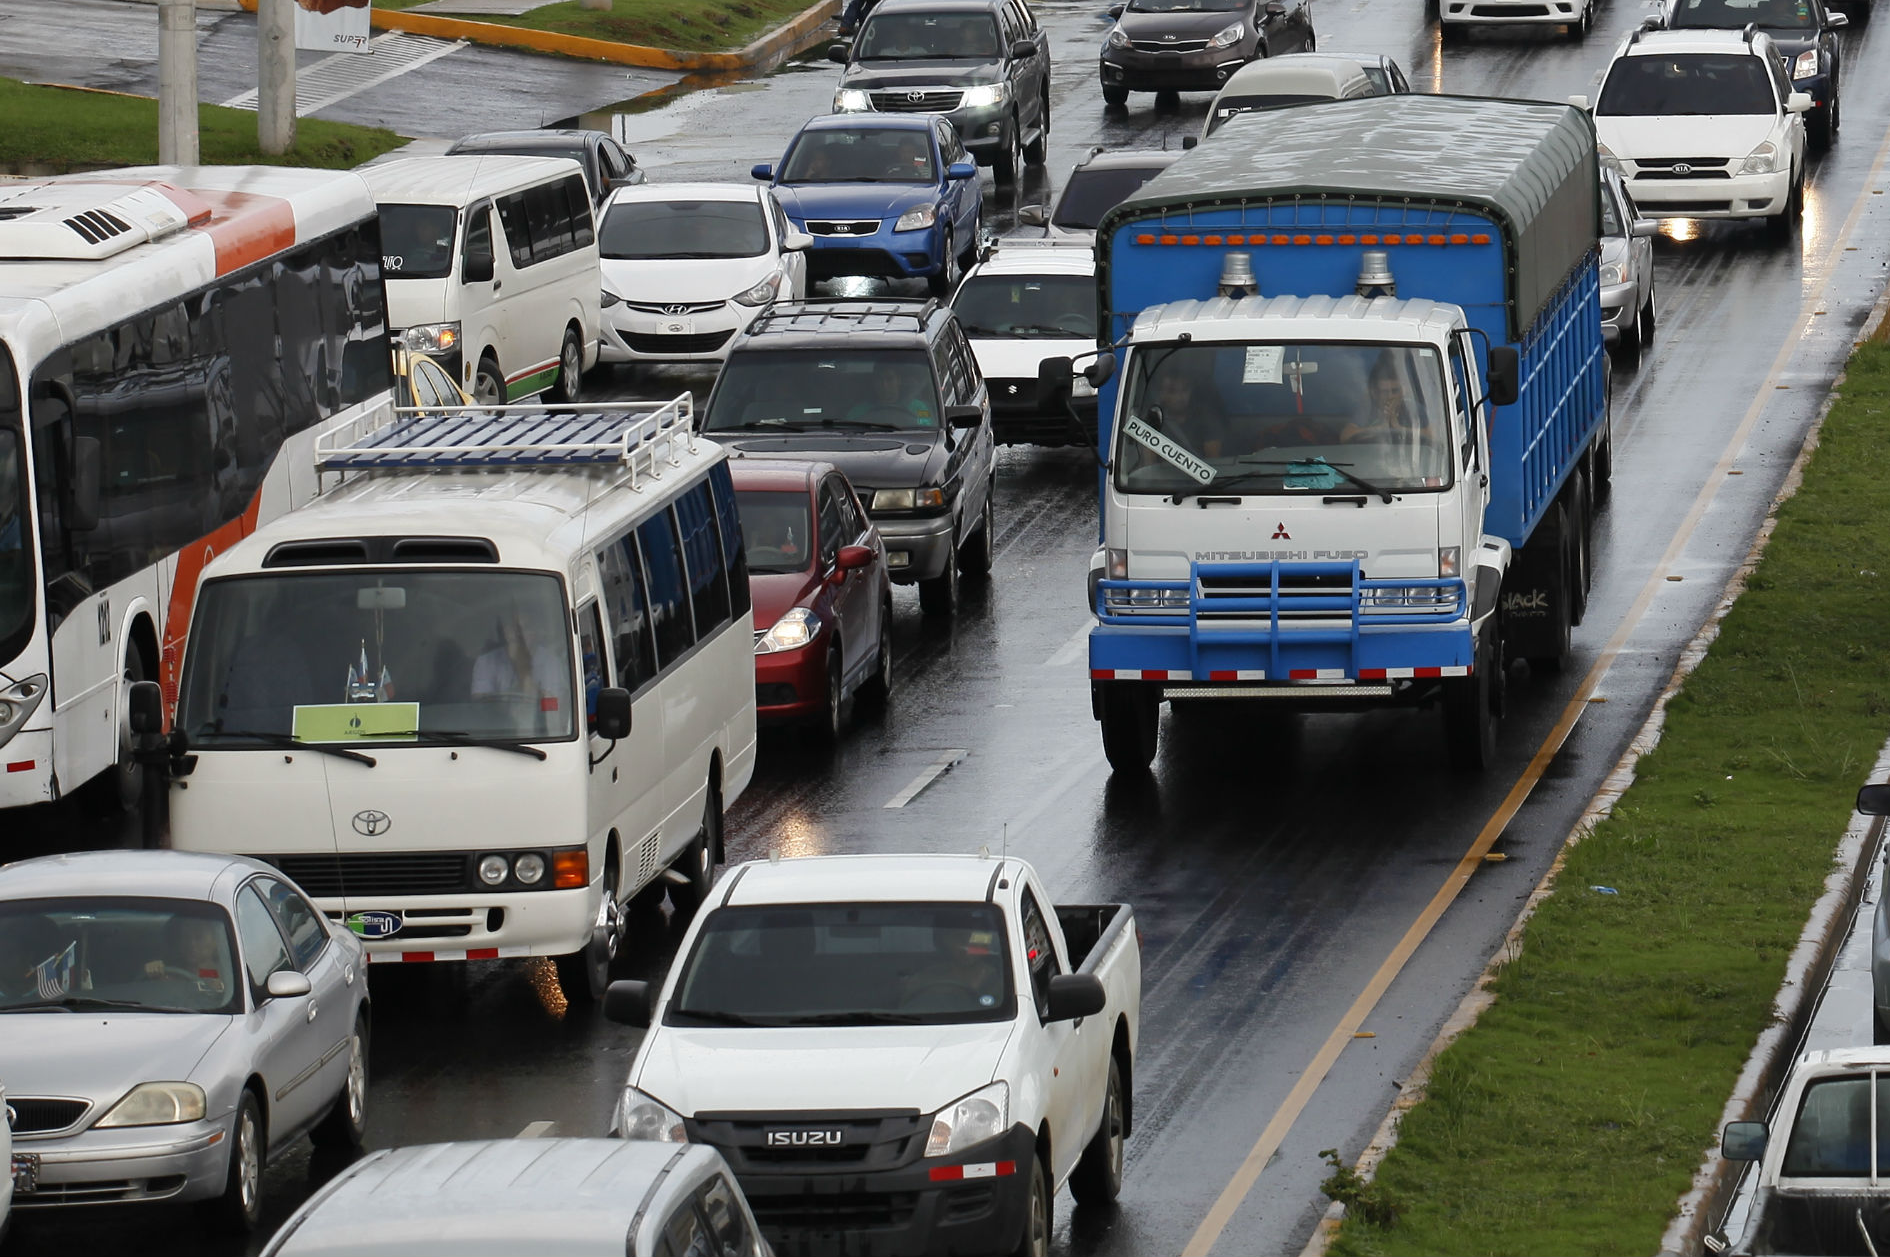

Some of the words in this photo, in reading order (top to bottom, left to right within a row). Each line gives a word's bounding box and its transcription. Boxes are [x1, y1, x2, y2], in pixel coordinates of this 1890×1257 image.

[1128, 421, 1161, 448] PURO
[1160, 442, 1211, 481] CUENTO
[1195, 550, 1308, 561] MITSUBISHI
[1314, 549, 1369, 560] FUSO
[768, 1131, 842, 1145] ISUZU
